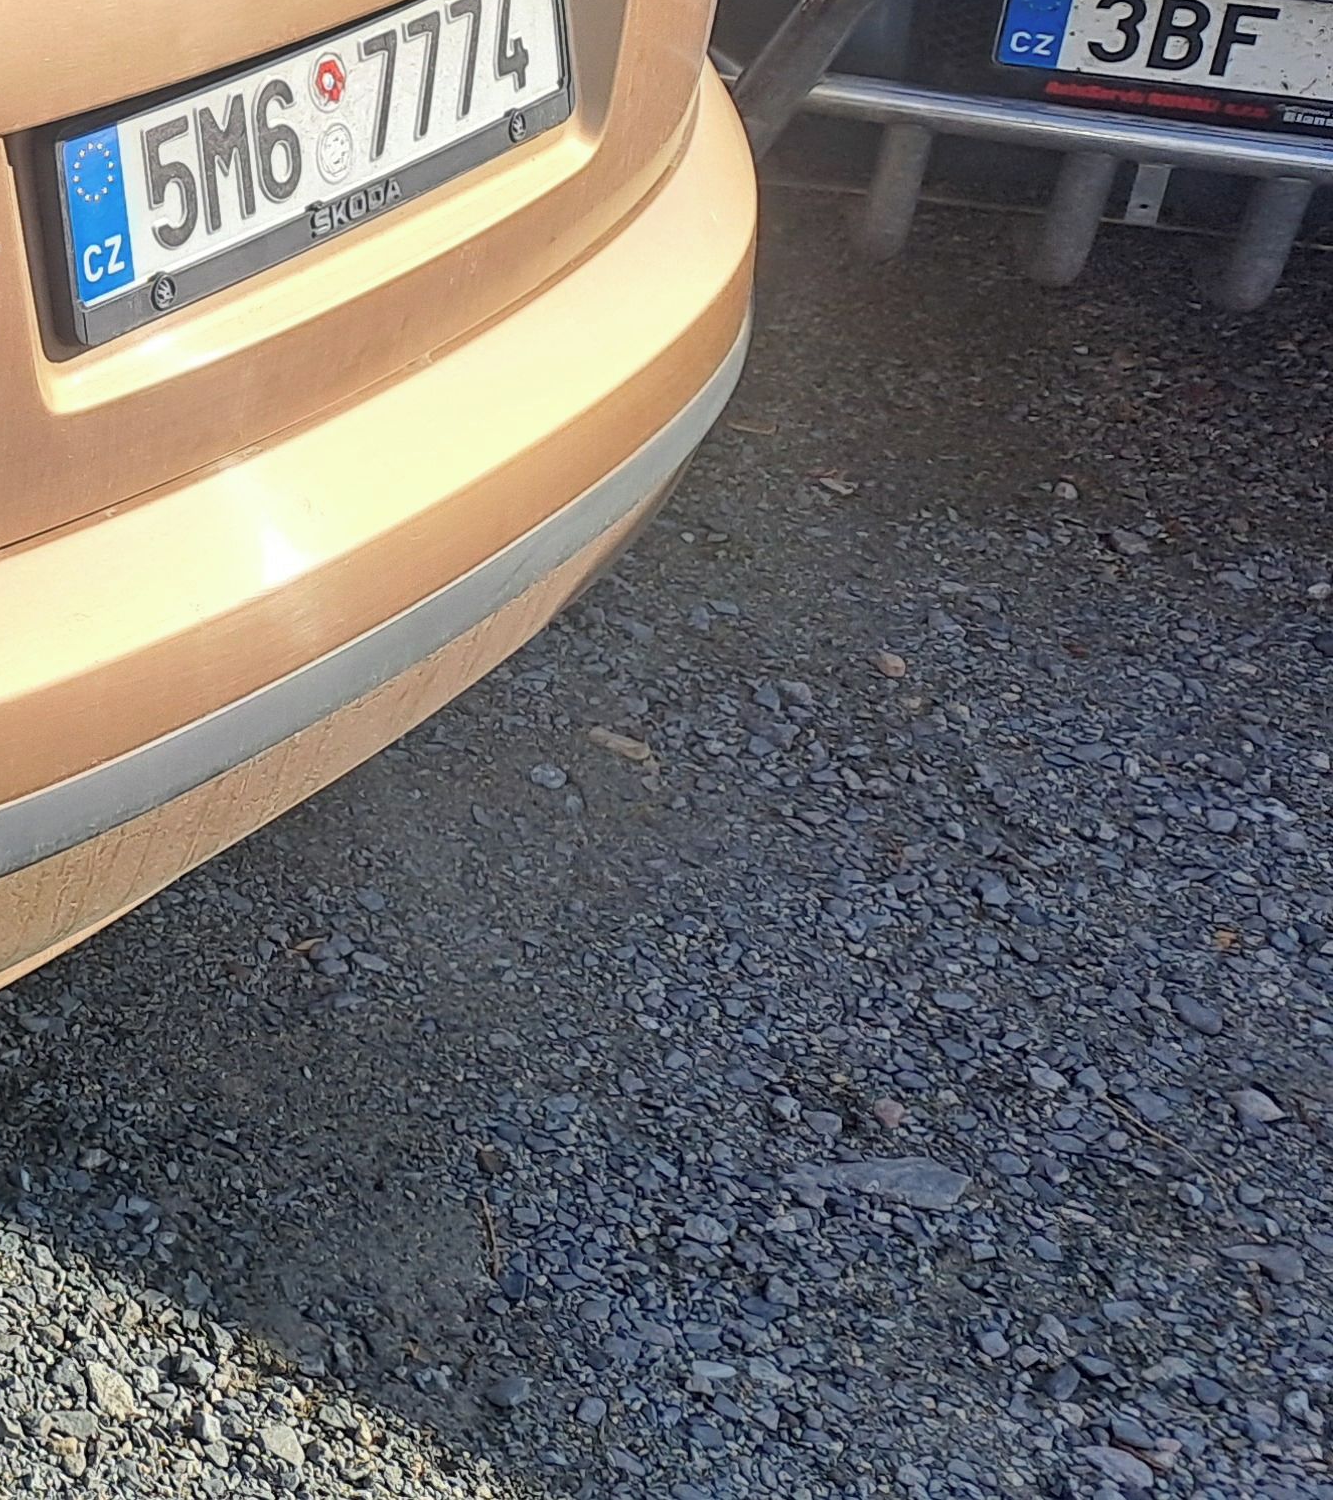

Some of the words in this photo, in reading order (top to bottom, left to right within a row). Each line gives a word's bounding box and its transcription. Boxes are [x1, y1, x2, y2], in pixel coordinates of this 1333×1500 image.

[1009, 31, 1057, 56] CZ
[141, 78, 301, 250] 5M6
[82, 235, 125, 284] CZ
